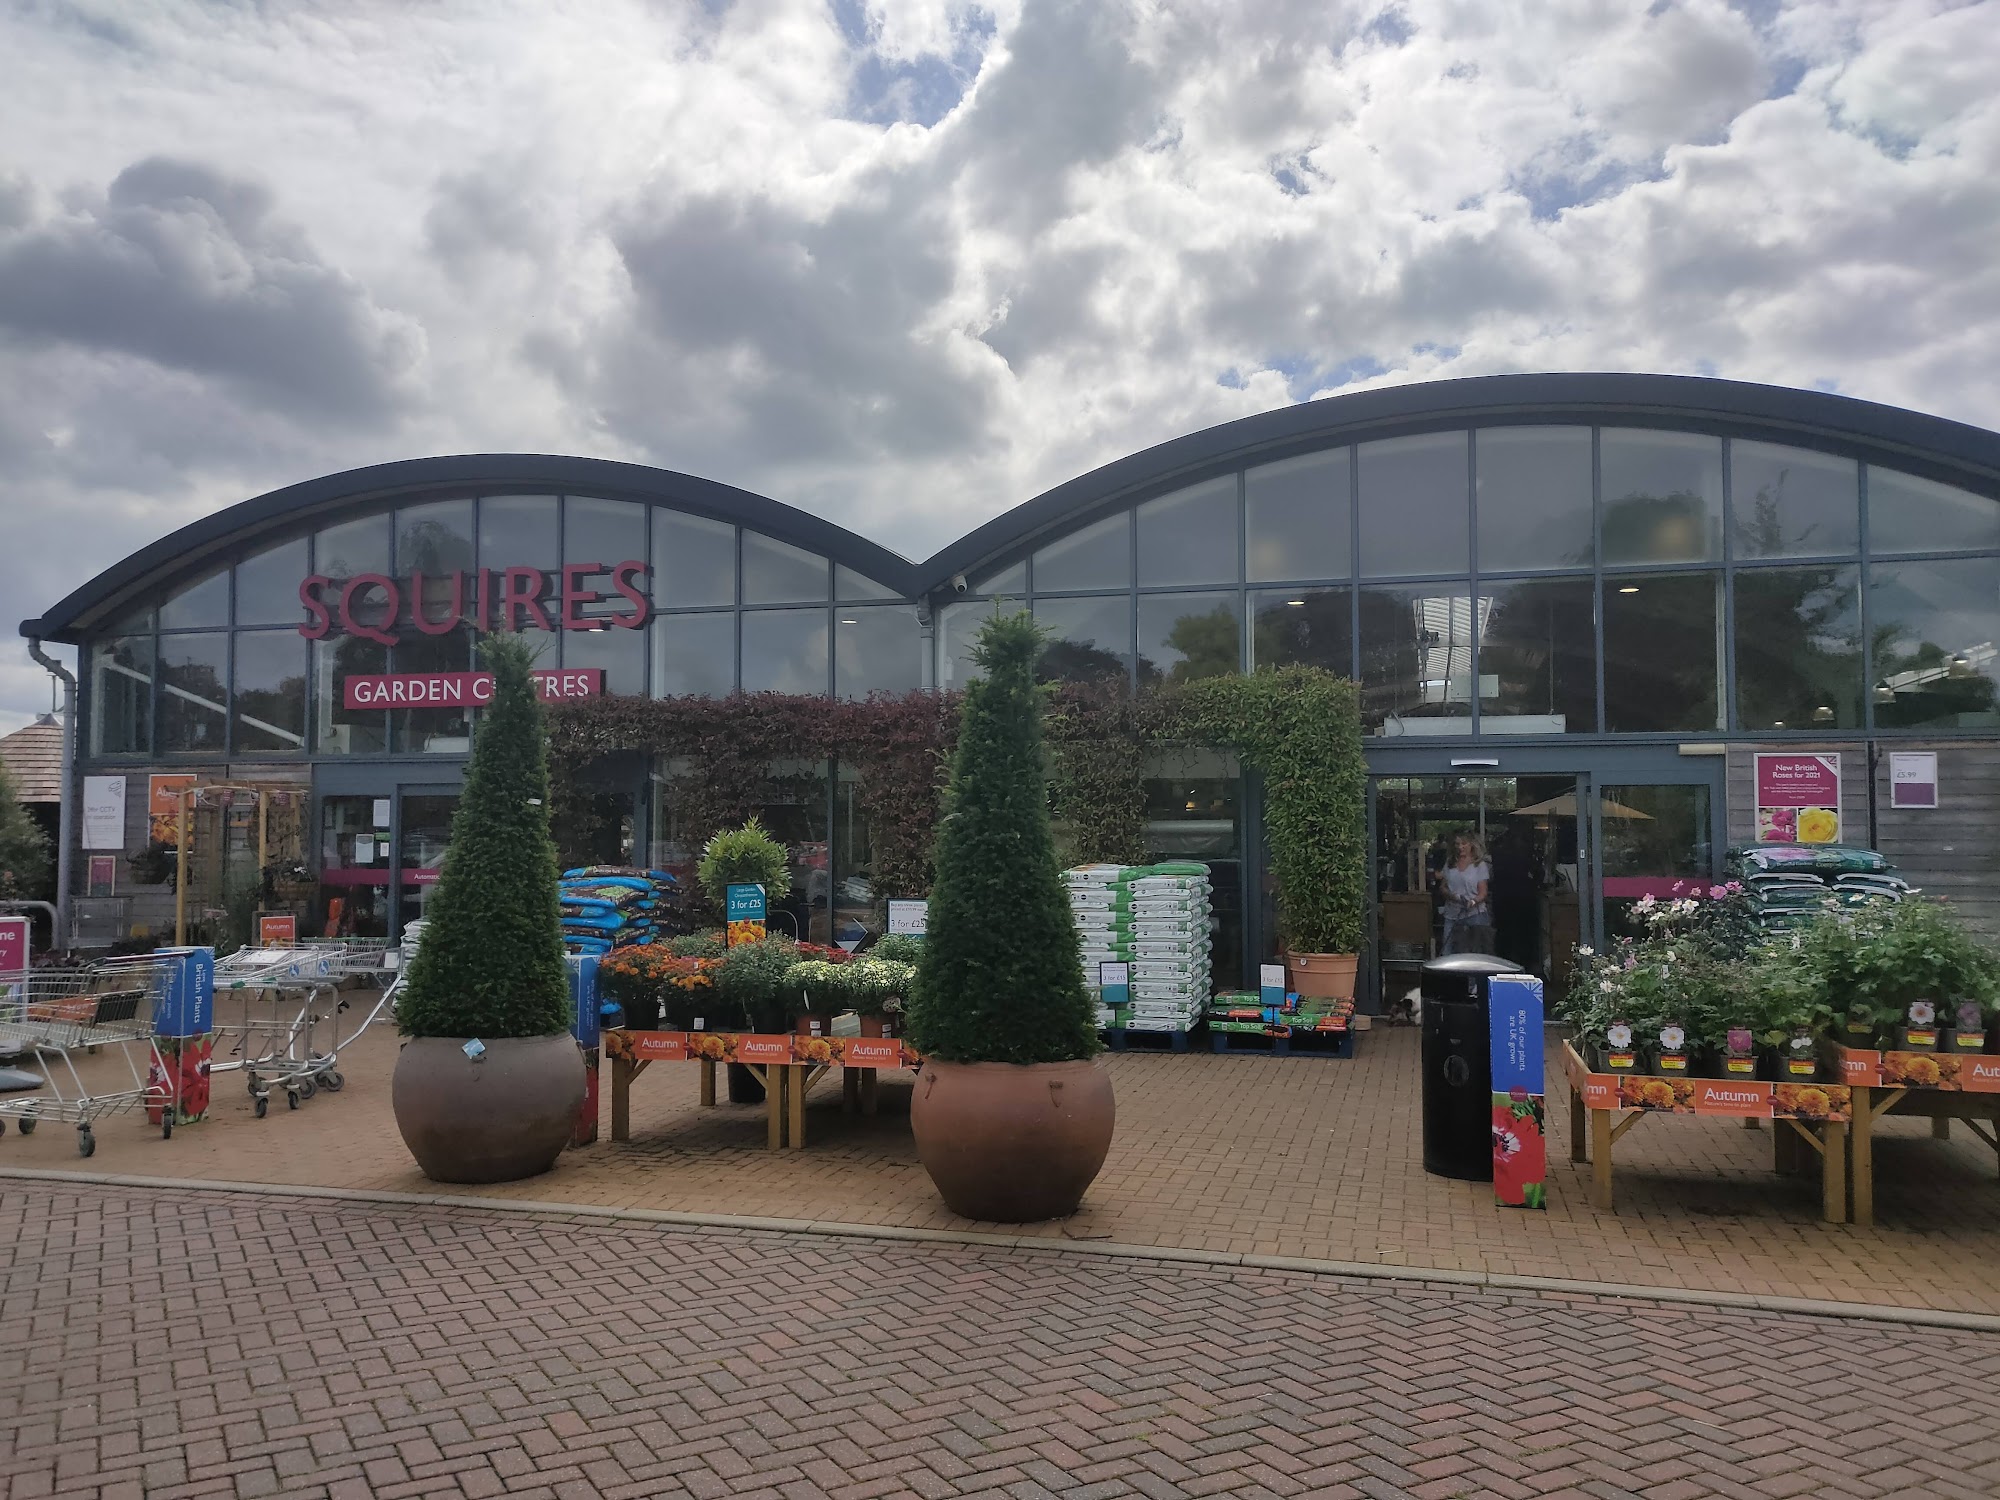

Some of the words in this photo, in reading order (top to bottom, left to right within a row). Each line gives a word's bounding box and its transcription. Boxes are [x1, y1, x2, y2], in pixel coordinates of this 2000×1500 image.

[298, 560, 648, 647] SQUIRES
[354, 679, 461, 703] GARDEN
[1896, 771, 1917, 779] £5.99
[731, 900, 736, 910] 3
[737, 900, 748, 909] for
[749, 899, 762, 909] £25
[265, 923, 291, 931] Autumn
[891, 919, 896, 927] 3
[897, 919, 910, 928] for
[911, 919, 925, 928] £25
[195, 963, 204, 993] British
[194, 995, 203, 1024] Plants
[1291, 1017, 1302, 1025] Top
[1518, 1009, 1527, 1025] 80%
[1240, 1023, 1250, 1031] Top
[1518, 1026, 1527, 1035] of
[1509, 1028, 1517, 1041] UK
[641, 1037, 678, 1049] Autumn
[744, 1040, 783, 1052] Autumn
[1518, 1035, 1526, 1049] our
[852, 1043, 892, 1056] Autumn
[1507, 1041, 1516, 1065] grown
[1517, 1050, 1526, 1072] plants
[1704, 1087, 1760, 1103] Autumn
